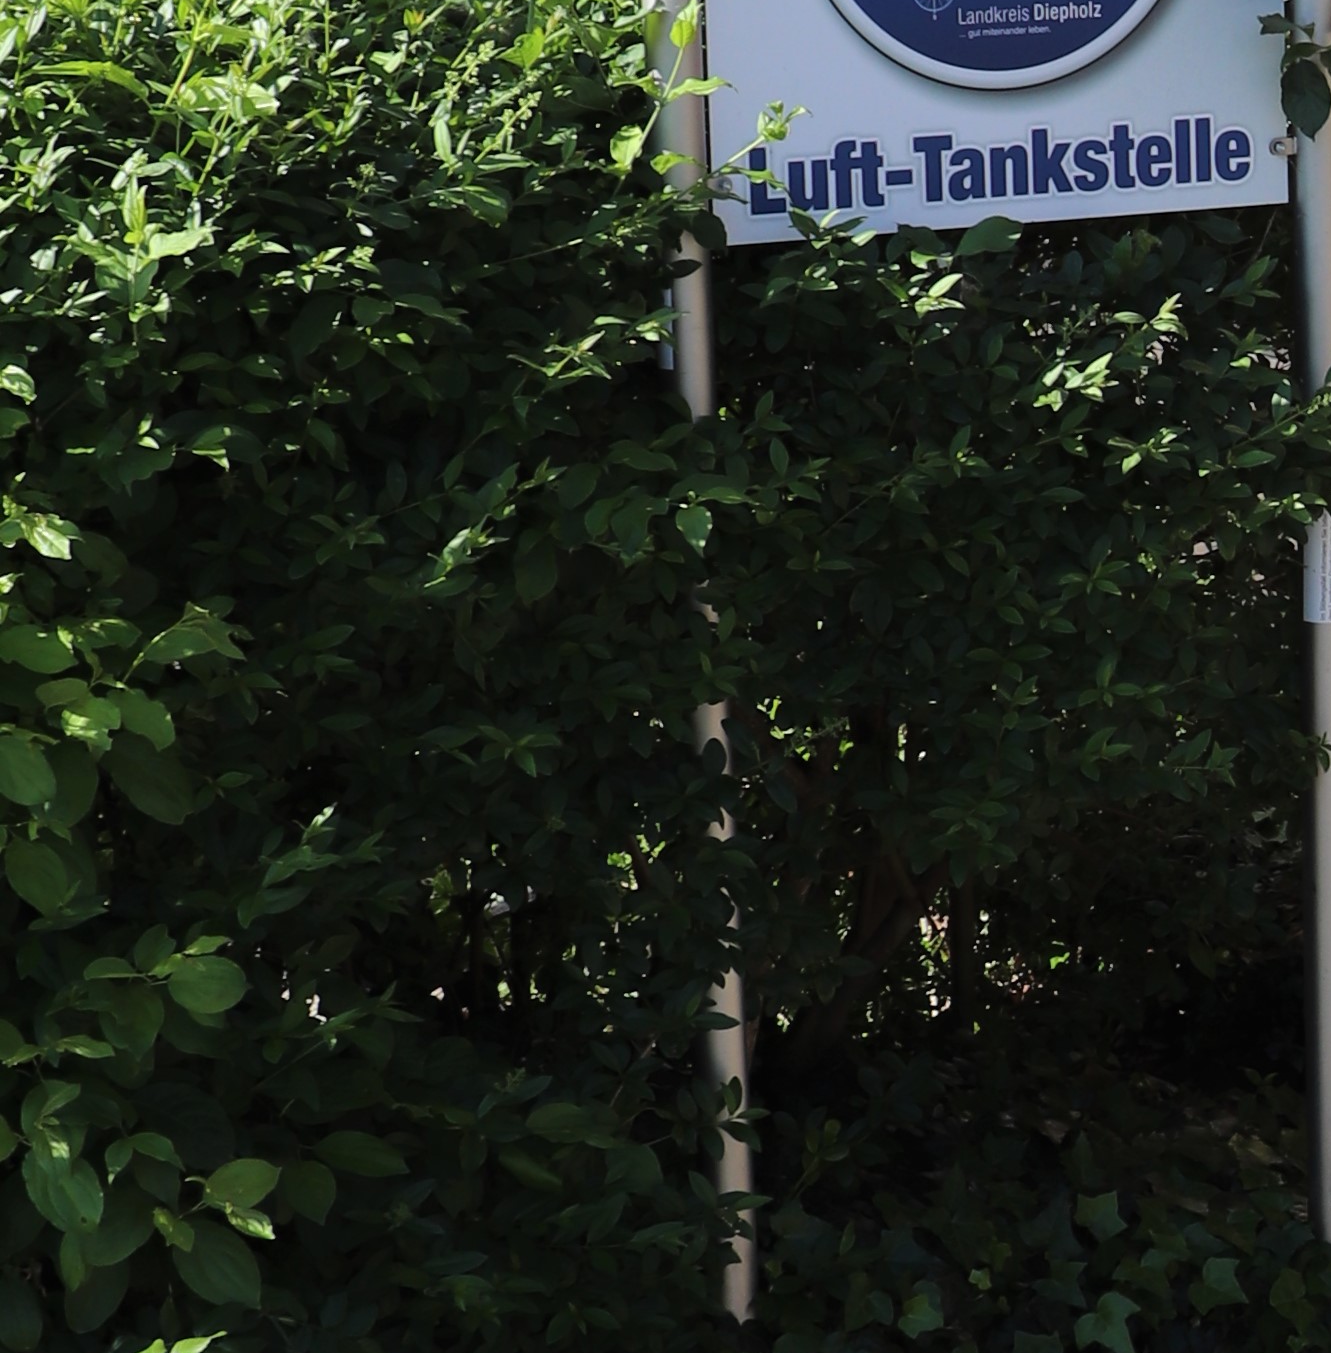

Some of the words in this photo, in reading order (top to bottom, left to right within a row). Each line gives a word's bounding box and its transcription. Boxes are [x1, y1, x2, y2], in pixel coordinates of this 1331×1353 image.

[958, 5, 1030, 25] Landkreis
[1033, 1, 1103, 23] Diepholz
[967, 28, 981, 39] gut
[982, 27, 1028, 37] miteinander
[1028, 25, 1052, 34] leben.
[748, 116, 1250, 216] Luft-Tankstelle
